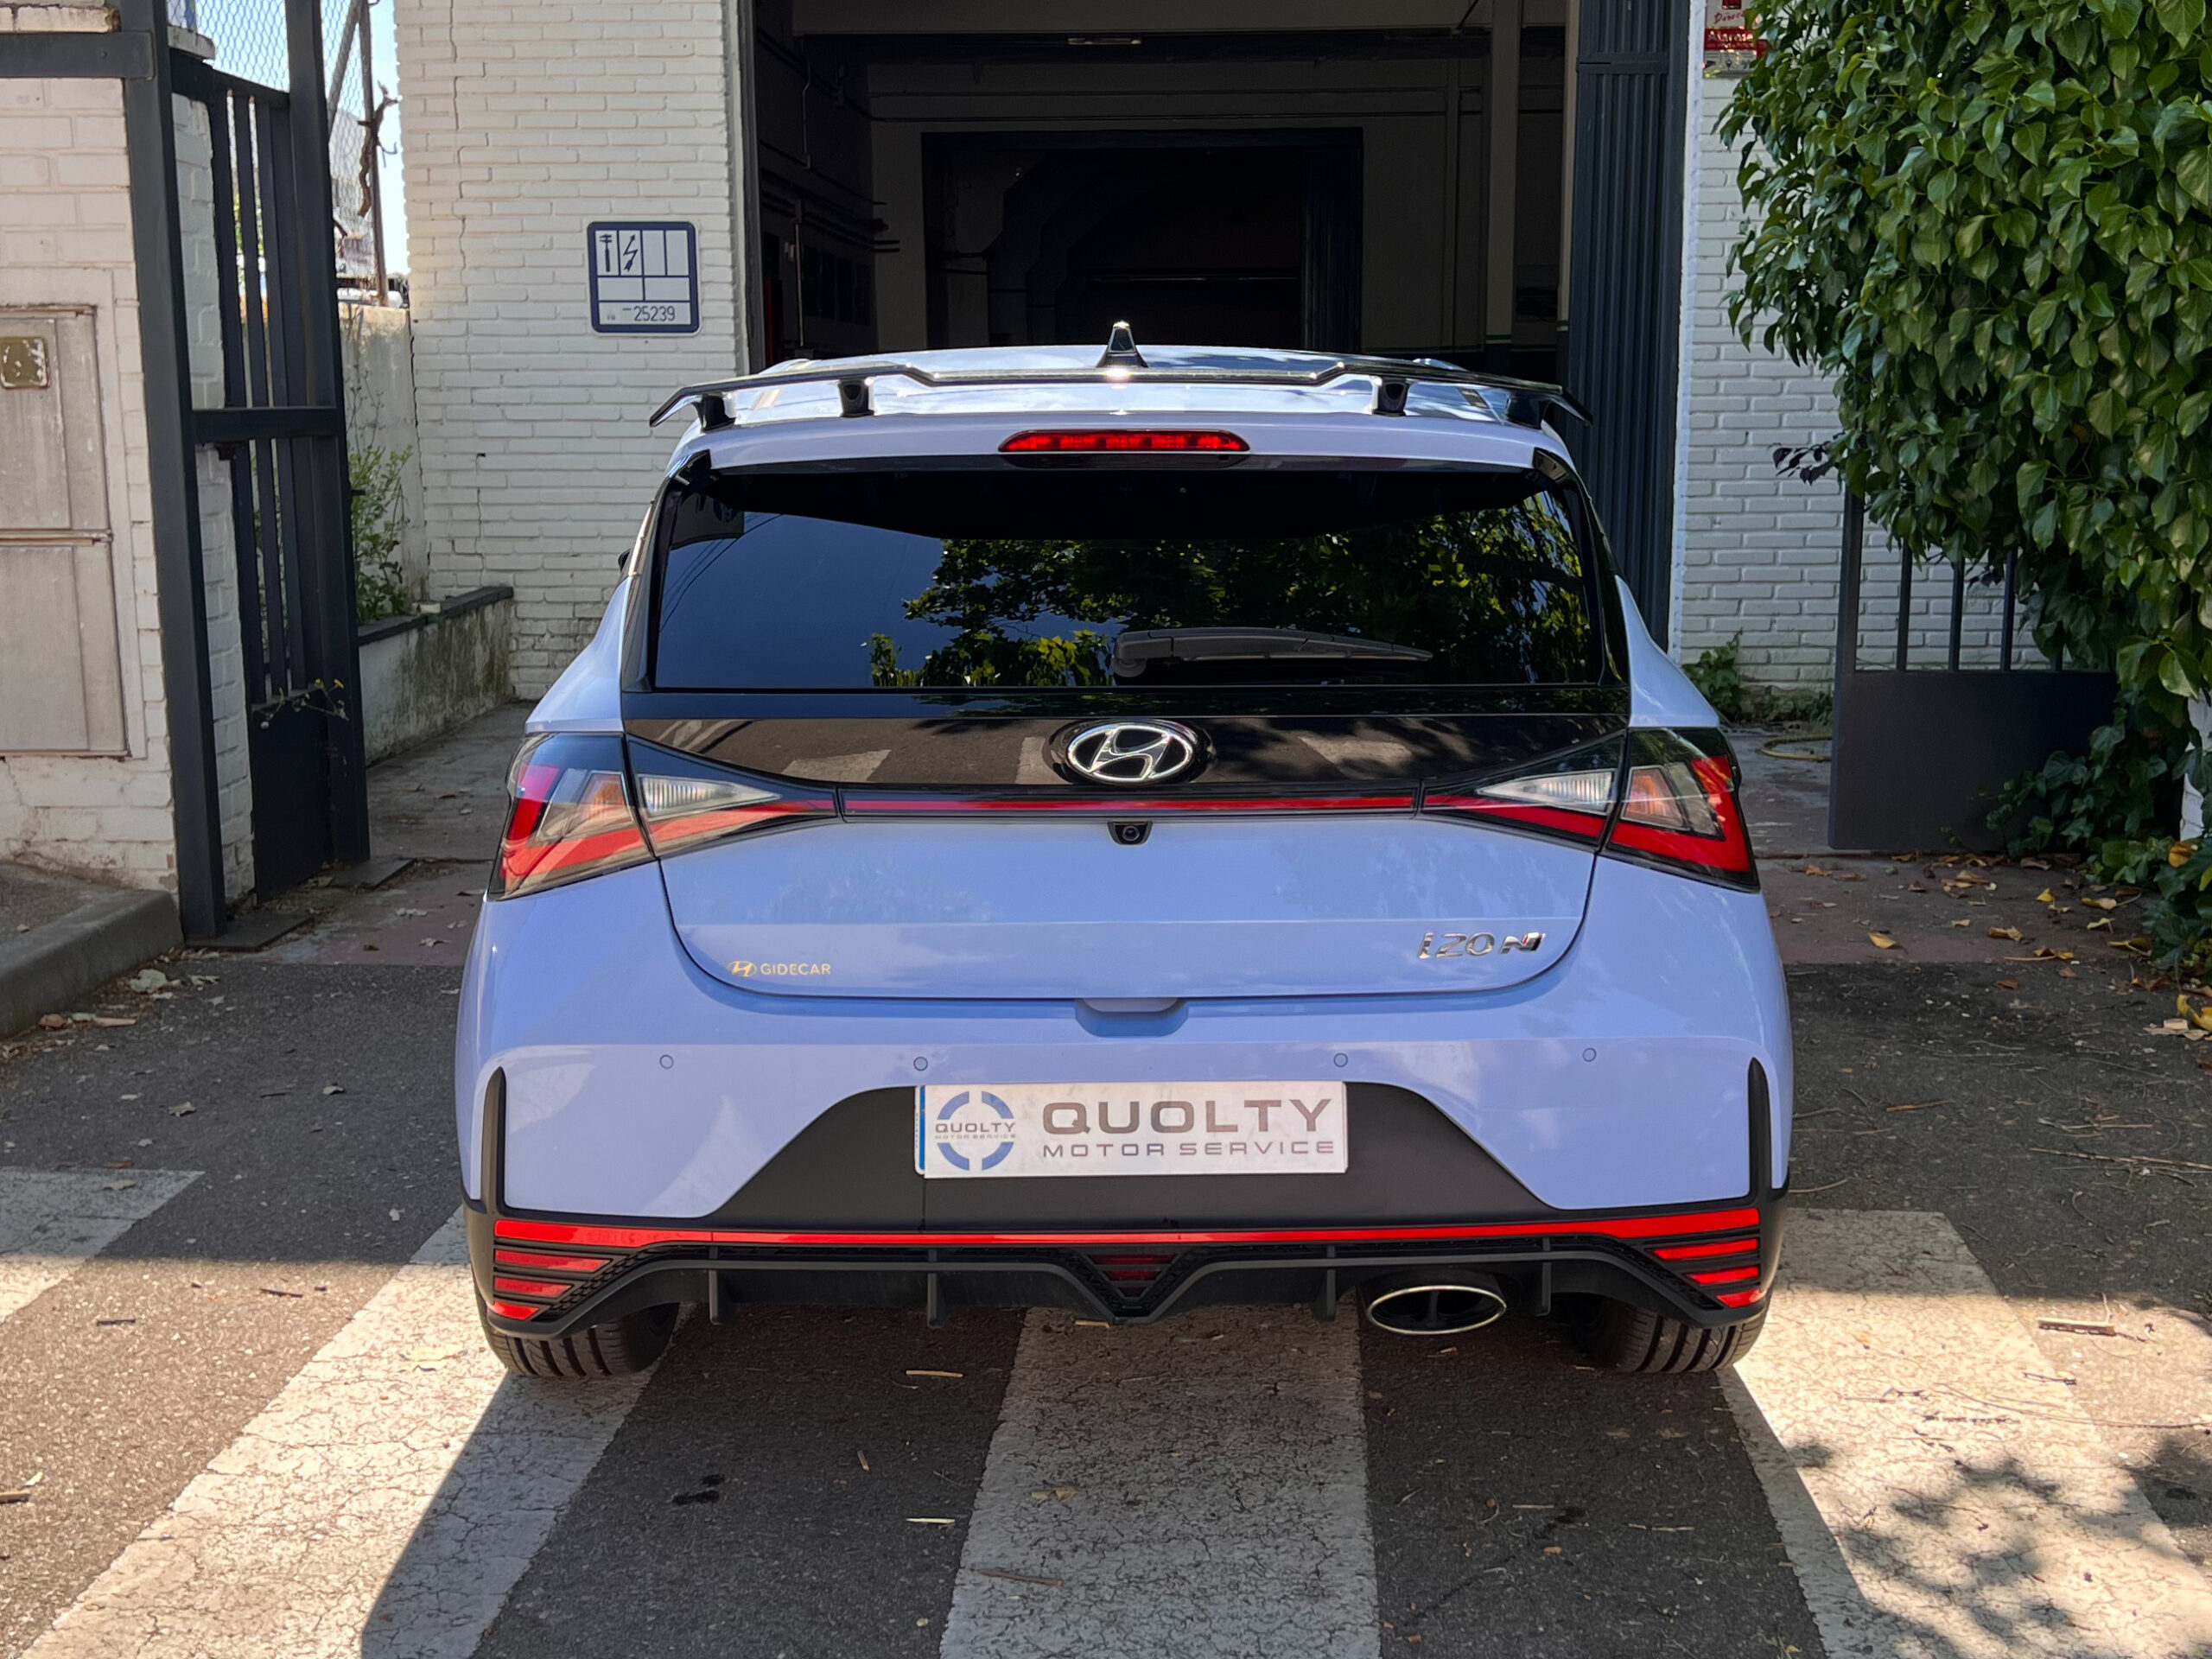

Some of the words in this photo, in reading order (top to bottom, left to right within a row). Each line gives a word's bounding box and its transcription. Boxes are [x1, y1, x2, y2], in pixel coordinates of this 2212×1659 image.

[1499, 931, 1547, 955] N
[760, 963, 831, 976] GIDECAR
[1042, 1098, 1332, 1135] QUOLTY
[935, 1122, 1016, 1133] QUOLTY
[1043, 1143, 1165, 1158] MOTOR
[1179, 1141, 1335, 1156] SERVICE
